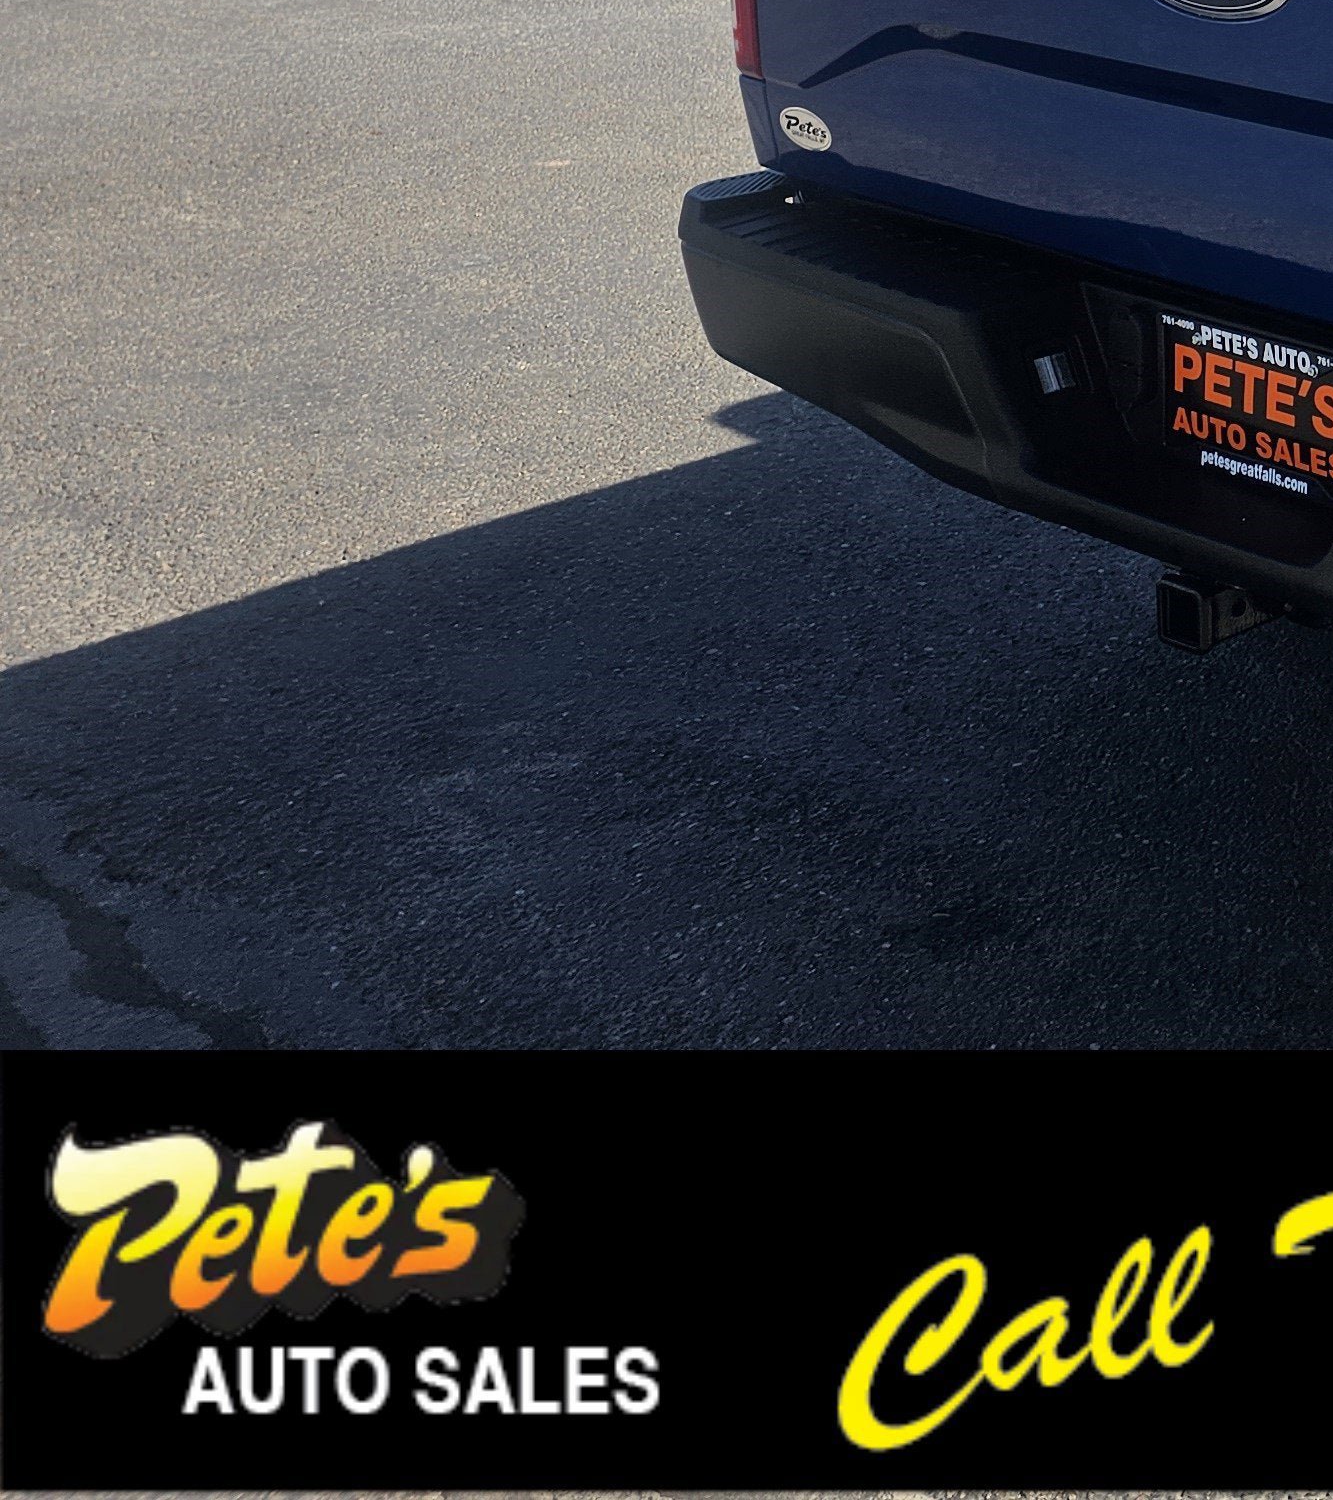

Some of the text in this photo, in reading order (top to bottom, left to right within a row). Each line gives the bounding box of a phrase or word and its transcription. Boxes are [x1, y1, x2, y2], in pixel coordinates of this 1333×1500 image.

[785, 114, 827, 139] Pete's
[1161, 314, 1195, 331] 761-4090
[1200, 324, 1311, 374] PETE'S AUTO
[1172, 406, 1247, 451] AUTO
[1200, 450, 1308, 495] petesgreatfalls.com
